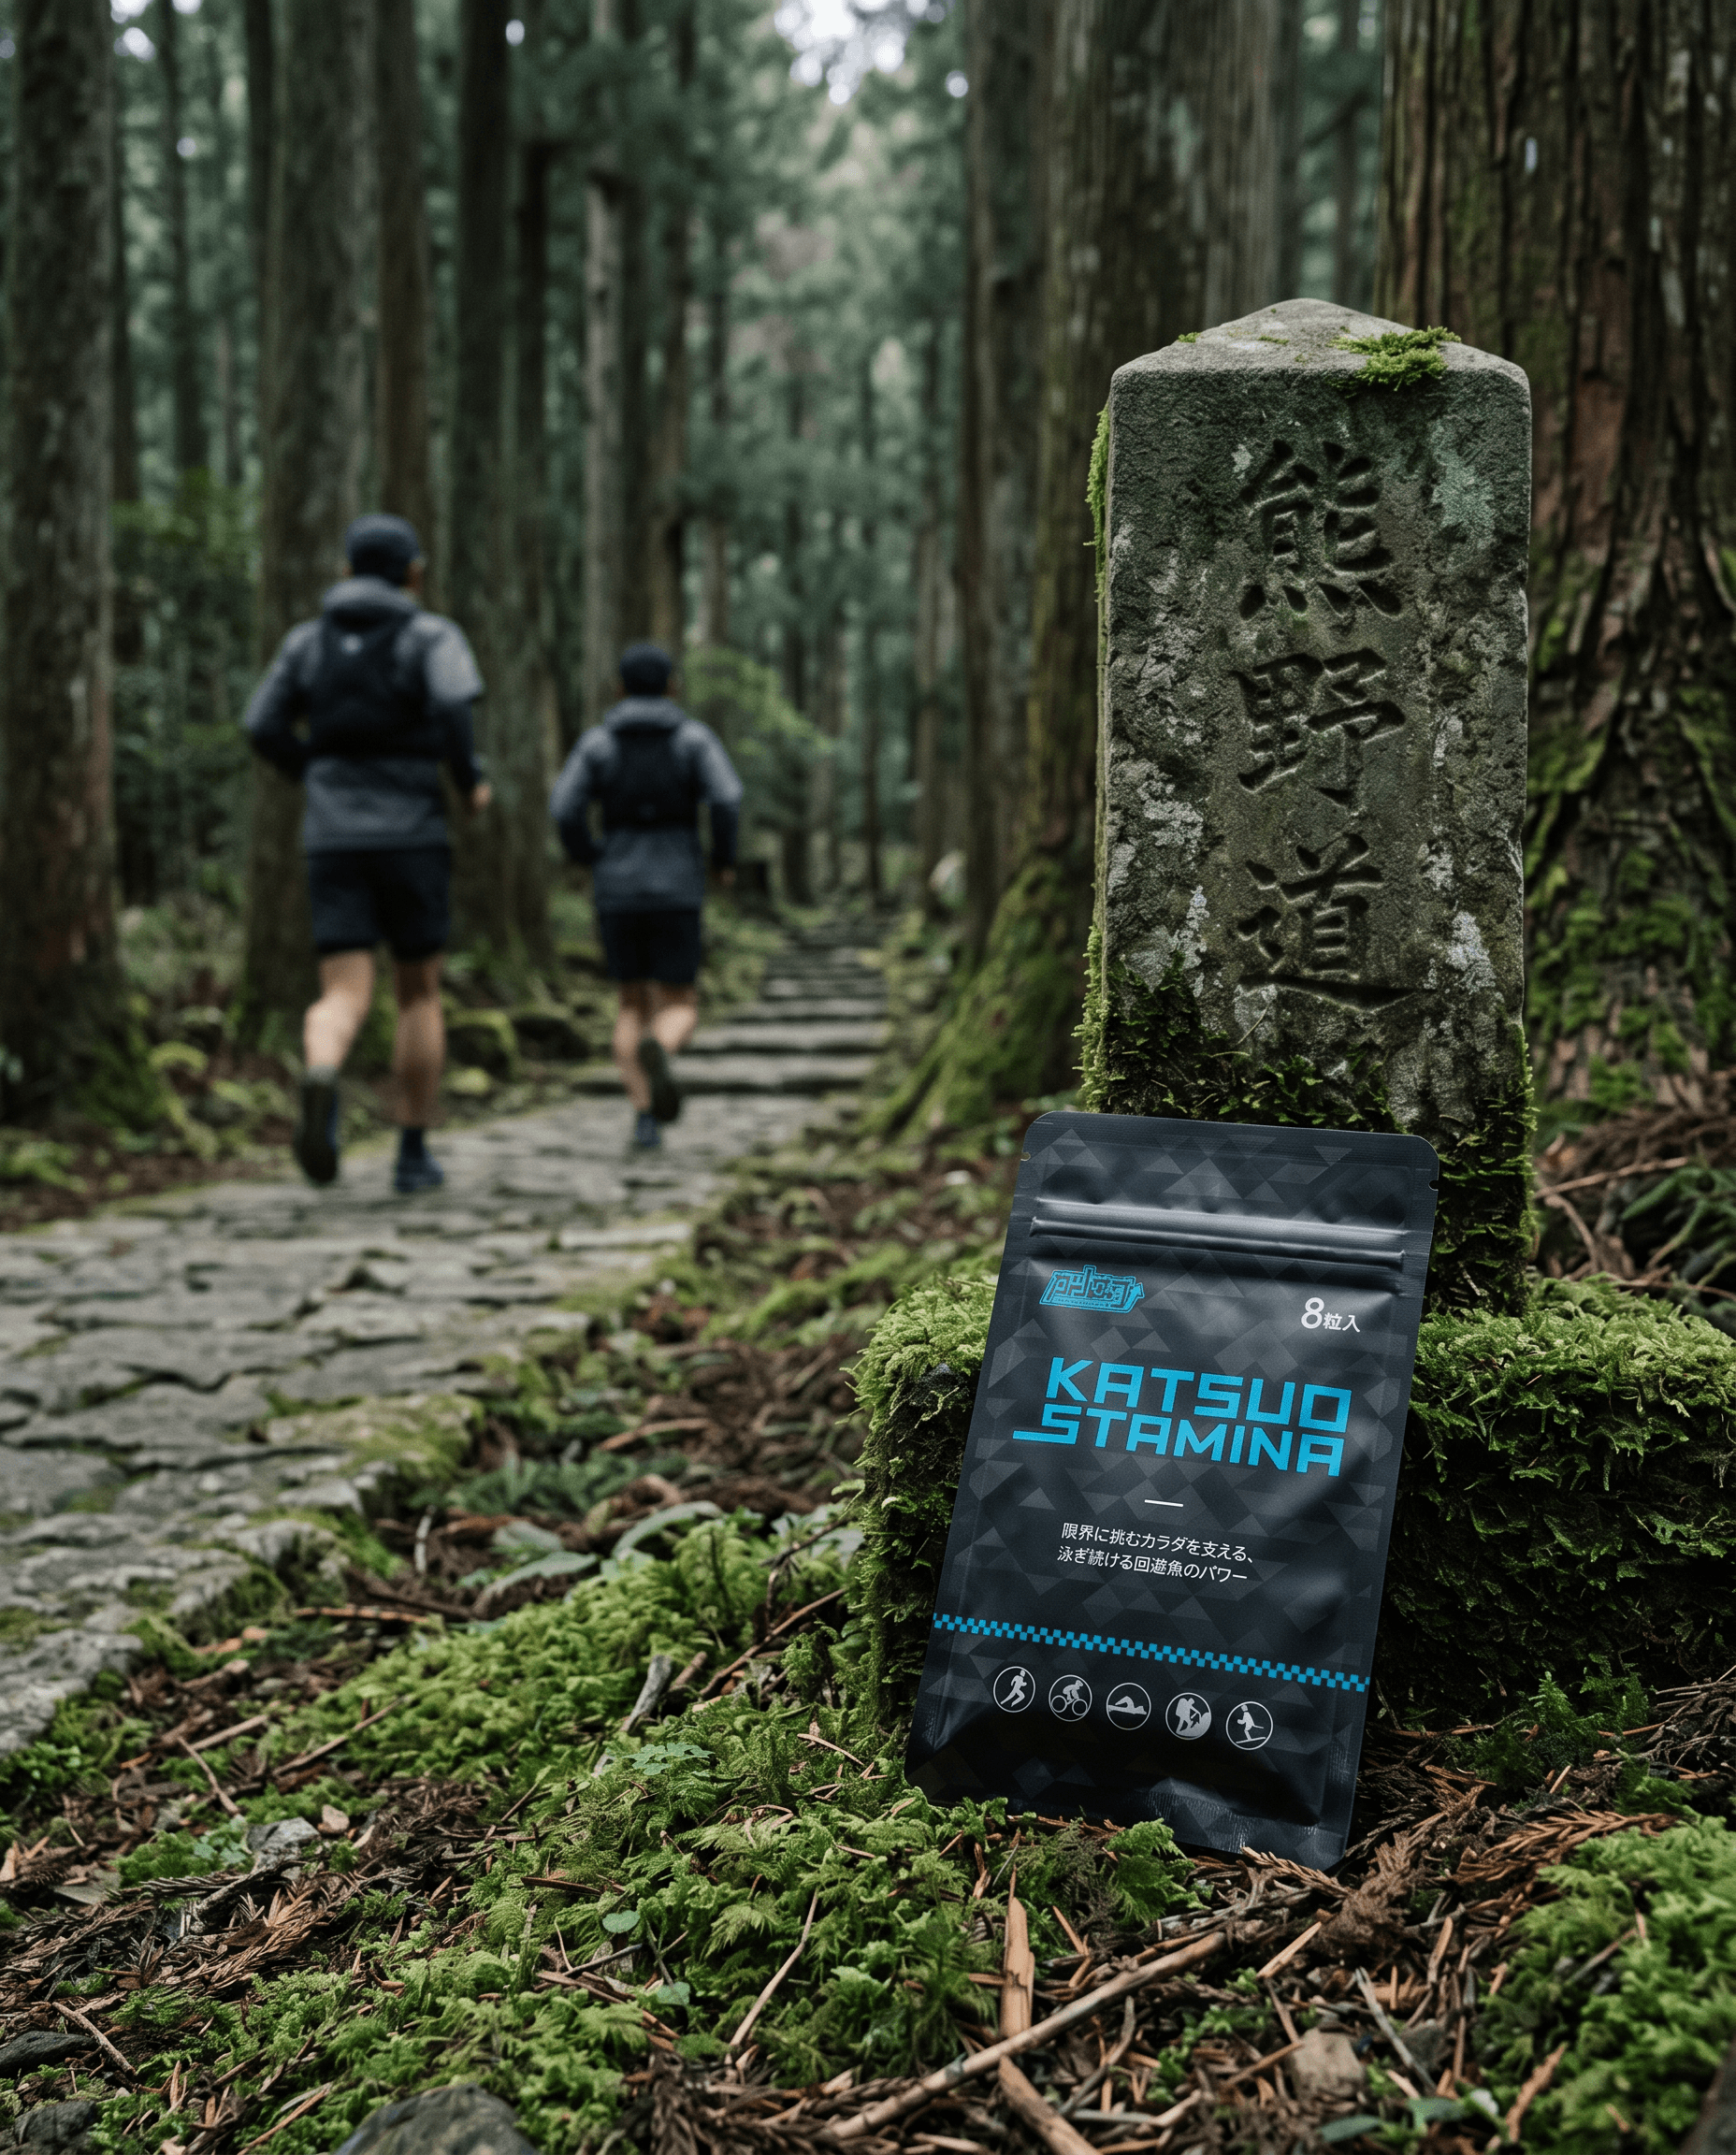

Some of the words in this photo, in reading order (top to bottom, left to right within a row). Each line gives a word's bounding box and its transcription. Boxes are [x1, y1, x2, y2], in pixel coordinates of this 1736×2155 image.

[1230, 438, 1435, 1011] 熊野道
[1301, 1296, 1361, 1333] 8粒入
[1046, 1356, 1353, 1433] KATSUO
[1012, 1403, 1345, 1477] STAMINA
[1057, 1545, 1248, 1583] 泳ぎ続ける回遊魚のパワー
[1061, 1522, 1253, 1563] 限界に挑むカラダを支える、
